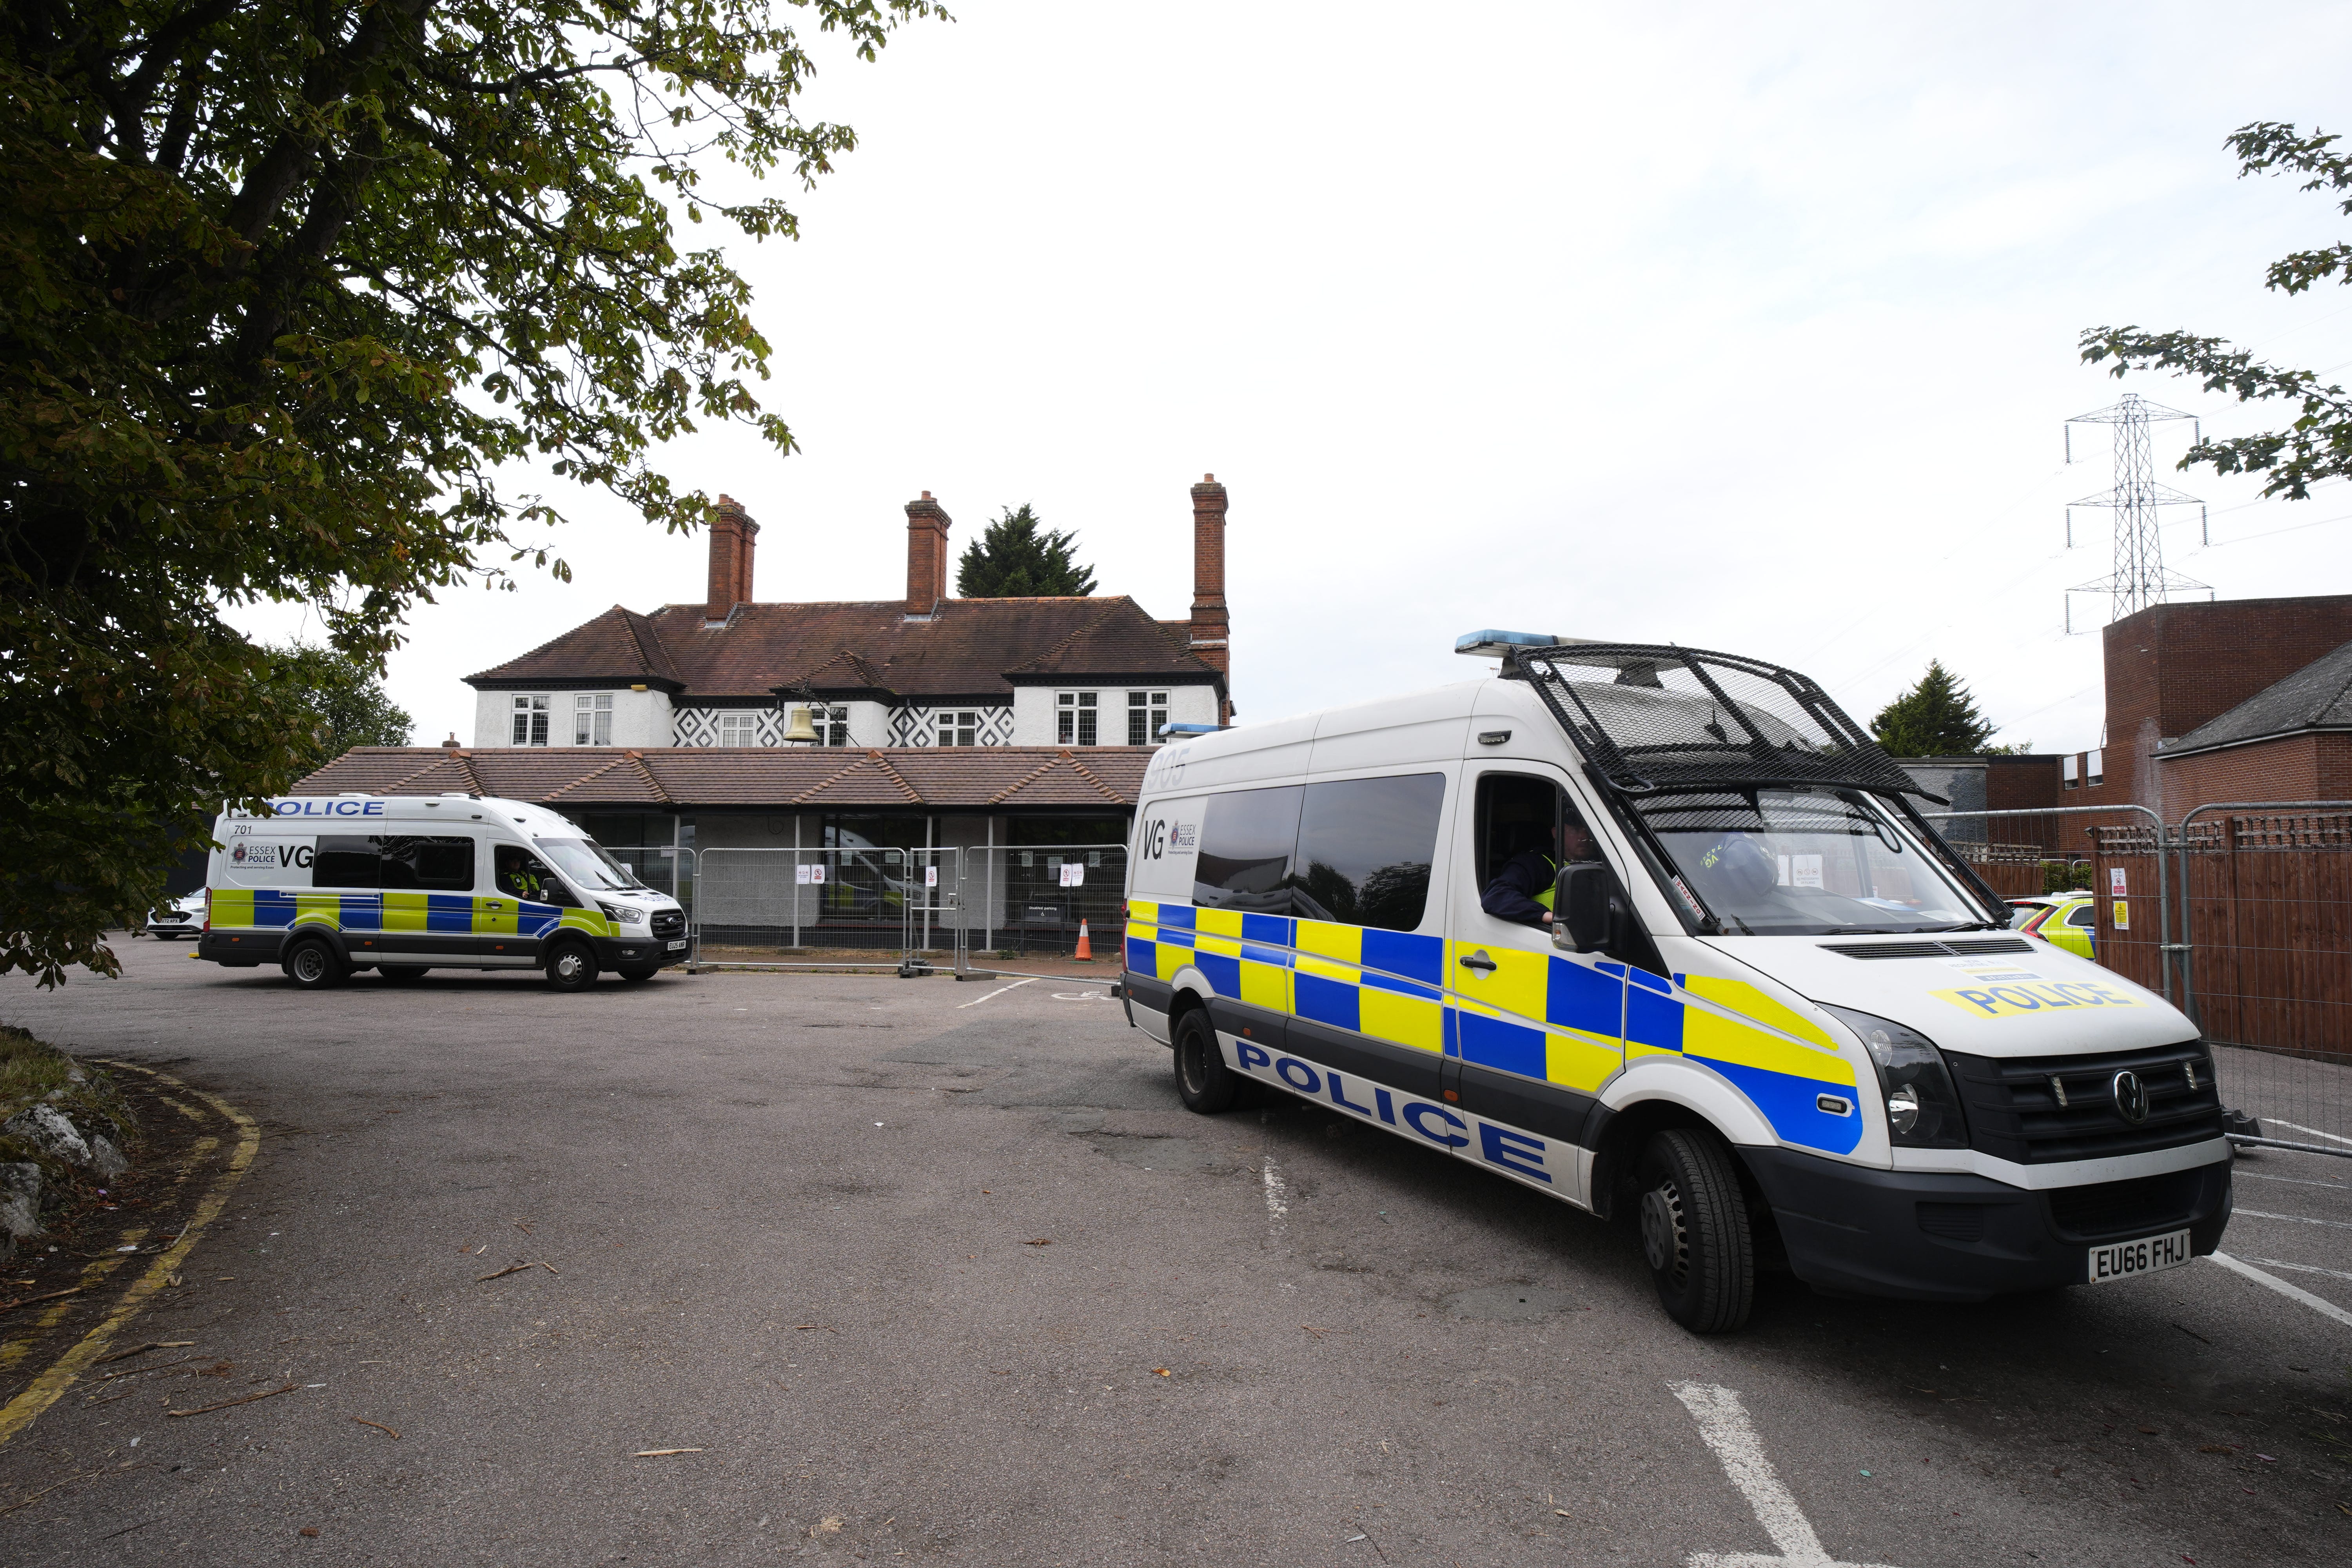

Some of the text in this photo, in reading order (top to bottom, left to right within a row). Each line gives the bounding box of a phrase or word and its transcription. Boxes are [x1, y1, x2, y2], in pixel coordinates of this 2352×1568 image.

[1147, 748, 1191, 789] 905
[265, 802, 385, 815] OLICE
[235, 825, 252, 834] 701
[1144, 819, 1165, 860] VG
[1180, 824, 1196, 835] ESSEX
[249, 846, 276, 855] ESSEX
[1178, 837, 1194, 846] POLICE
[278, 846, 314, 868] VG
[1705, 855, 1719, 867] VG
[1676, 880, 1700, 914] WARNING
[1954, 983, 2134, 1014] POLICE
[1236, 1040, 1553, 1184] POLICE
[2098, 1235, 2184, 1278] EU66 FHJ
